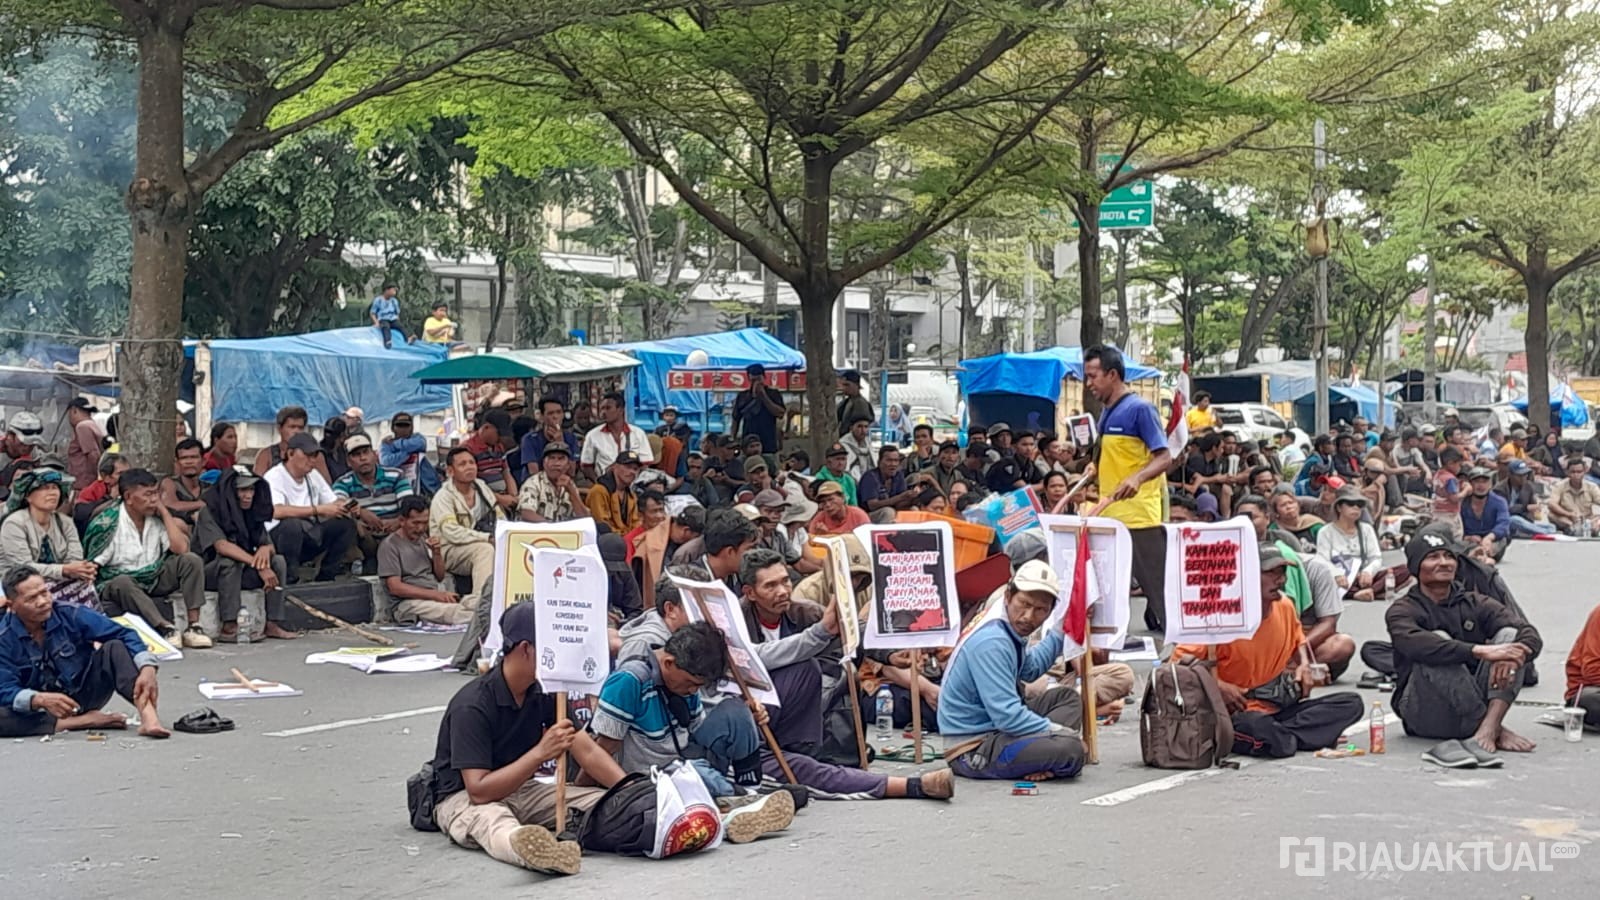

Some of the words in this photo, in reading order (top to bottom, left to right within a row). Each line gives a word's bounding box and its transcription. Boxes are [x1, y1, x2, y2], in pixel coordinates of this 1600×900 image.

[1185, 544, 1208, 557] KAMI
[1209, 543, 1237, 557] AKAN
[880, 553, 900, 564] KAMI
[902, 552, 937, 563] RAKYAT
[893, 565, 922, 575] BIASA!
[888, 576, 908, 586] TAPI
[909, 575, 932, 585] KAMI
[1186, 573, 1208, 586] DEMI
[1209, 573, 1237, 586] HIDUP
[886, 588, 916, 597] PUNYA
[917, 587, 937, 596] HAK
[1200, 587, 1222, 599] DAN
[884, 599, 910, 609] YANG
[912, 599, 939, 608] SAMA!
[1182, 601, 1216, 615] TANAH
